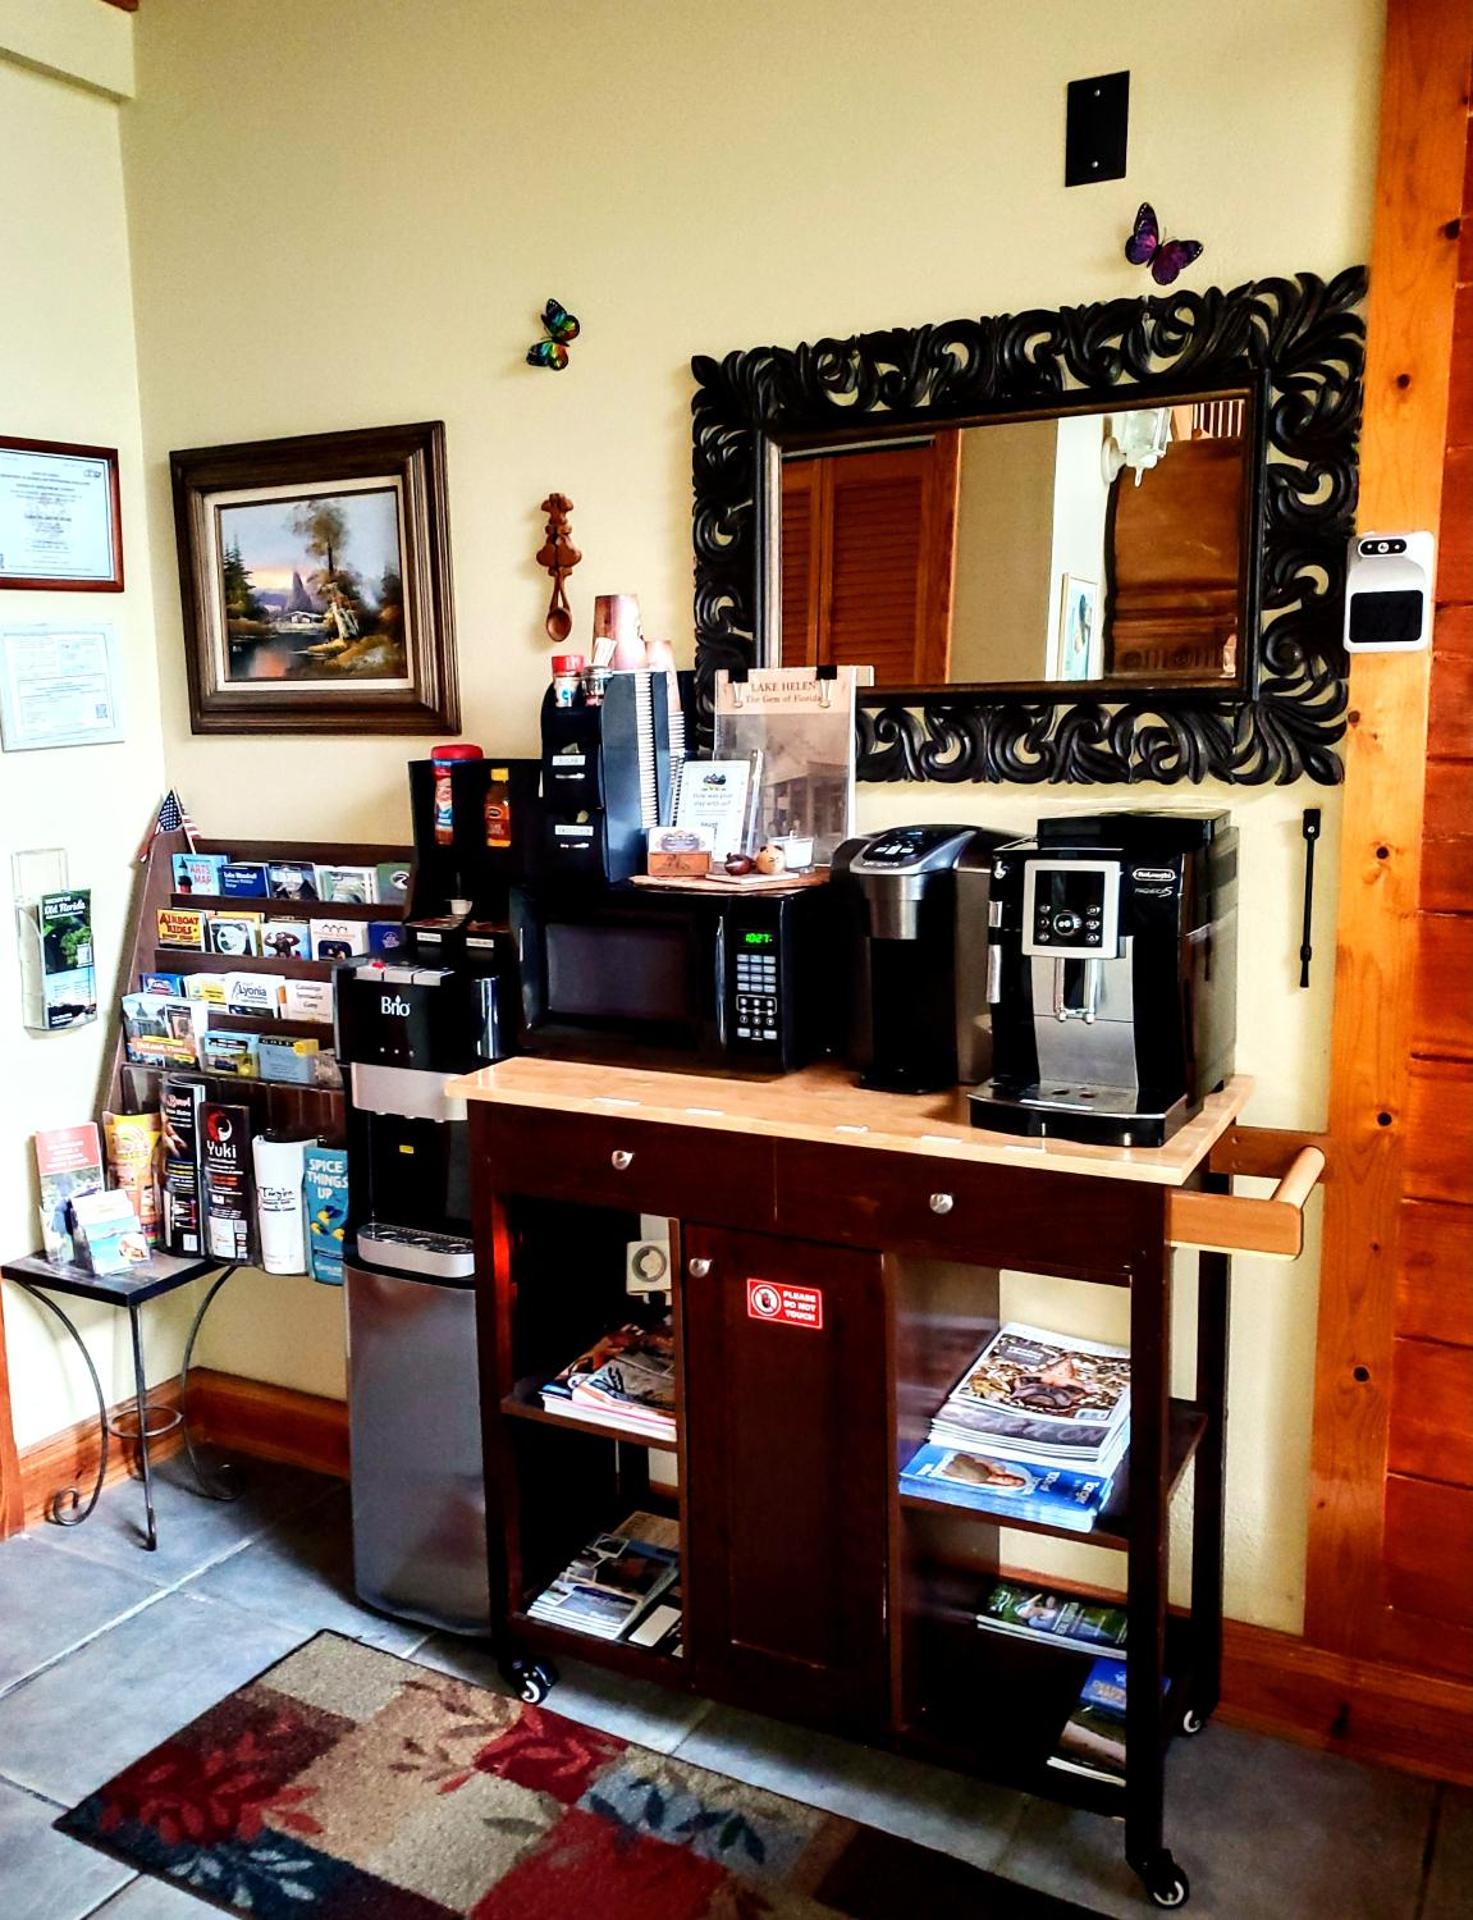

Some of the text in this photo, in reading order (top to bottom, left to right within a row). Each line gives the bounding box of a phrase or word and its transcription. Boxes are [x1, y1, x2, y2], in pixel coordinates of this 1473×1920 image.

[751, 680, 817, 693] LAKE HELEN
[44, 905, 58, 915] Old
[159, 912, 200, 926] AIRBOAT
[166, 924, 193, 936] RIDES
[238, 984, 267, 997] Lyonia
[381, 994, 410, 1017] Brio
[206, 1139, 236, 1159] Yuki
[308, 1158, 345, 1173] SPICE
[307, 1171, 349, 1189] THINGS
[317, 1186, 333, 1200] UP
[782, 1290, 816, 1303] PLEASE
[783, 1300, 816, 1312] DO NOT
[785, 1309, 816, 1322] TOUCH
